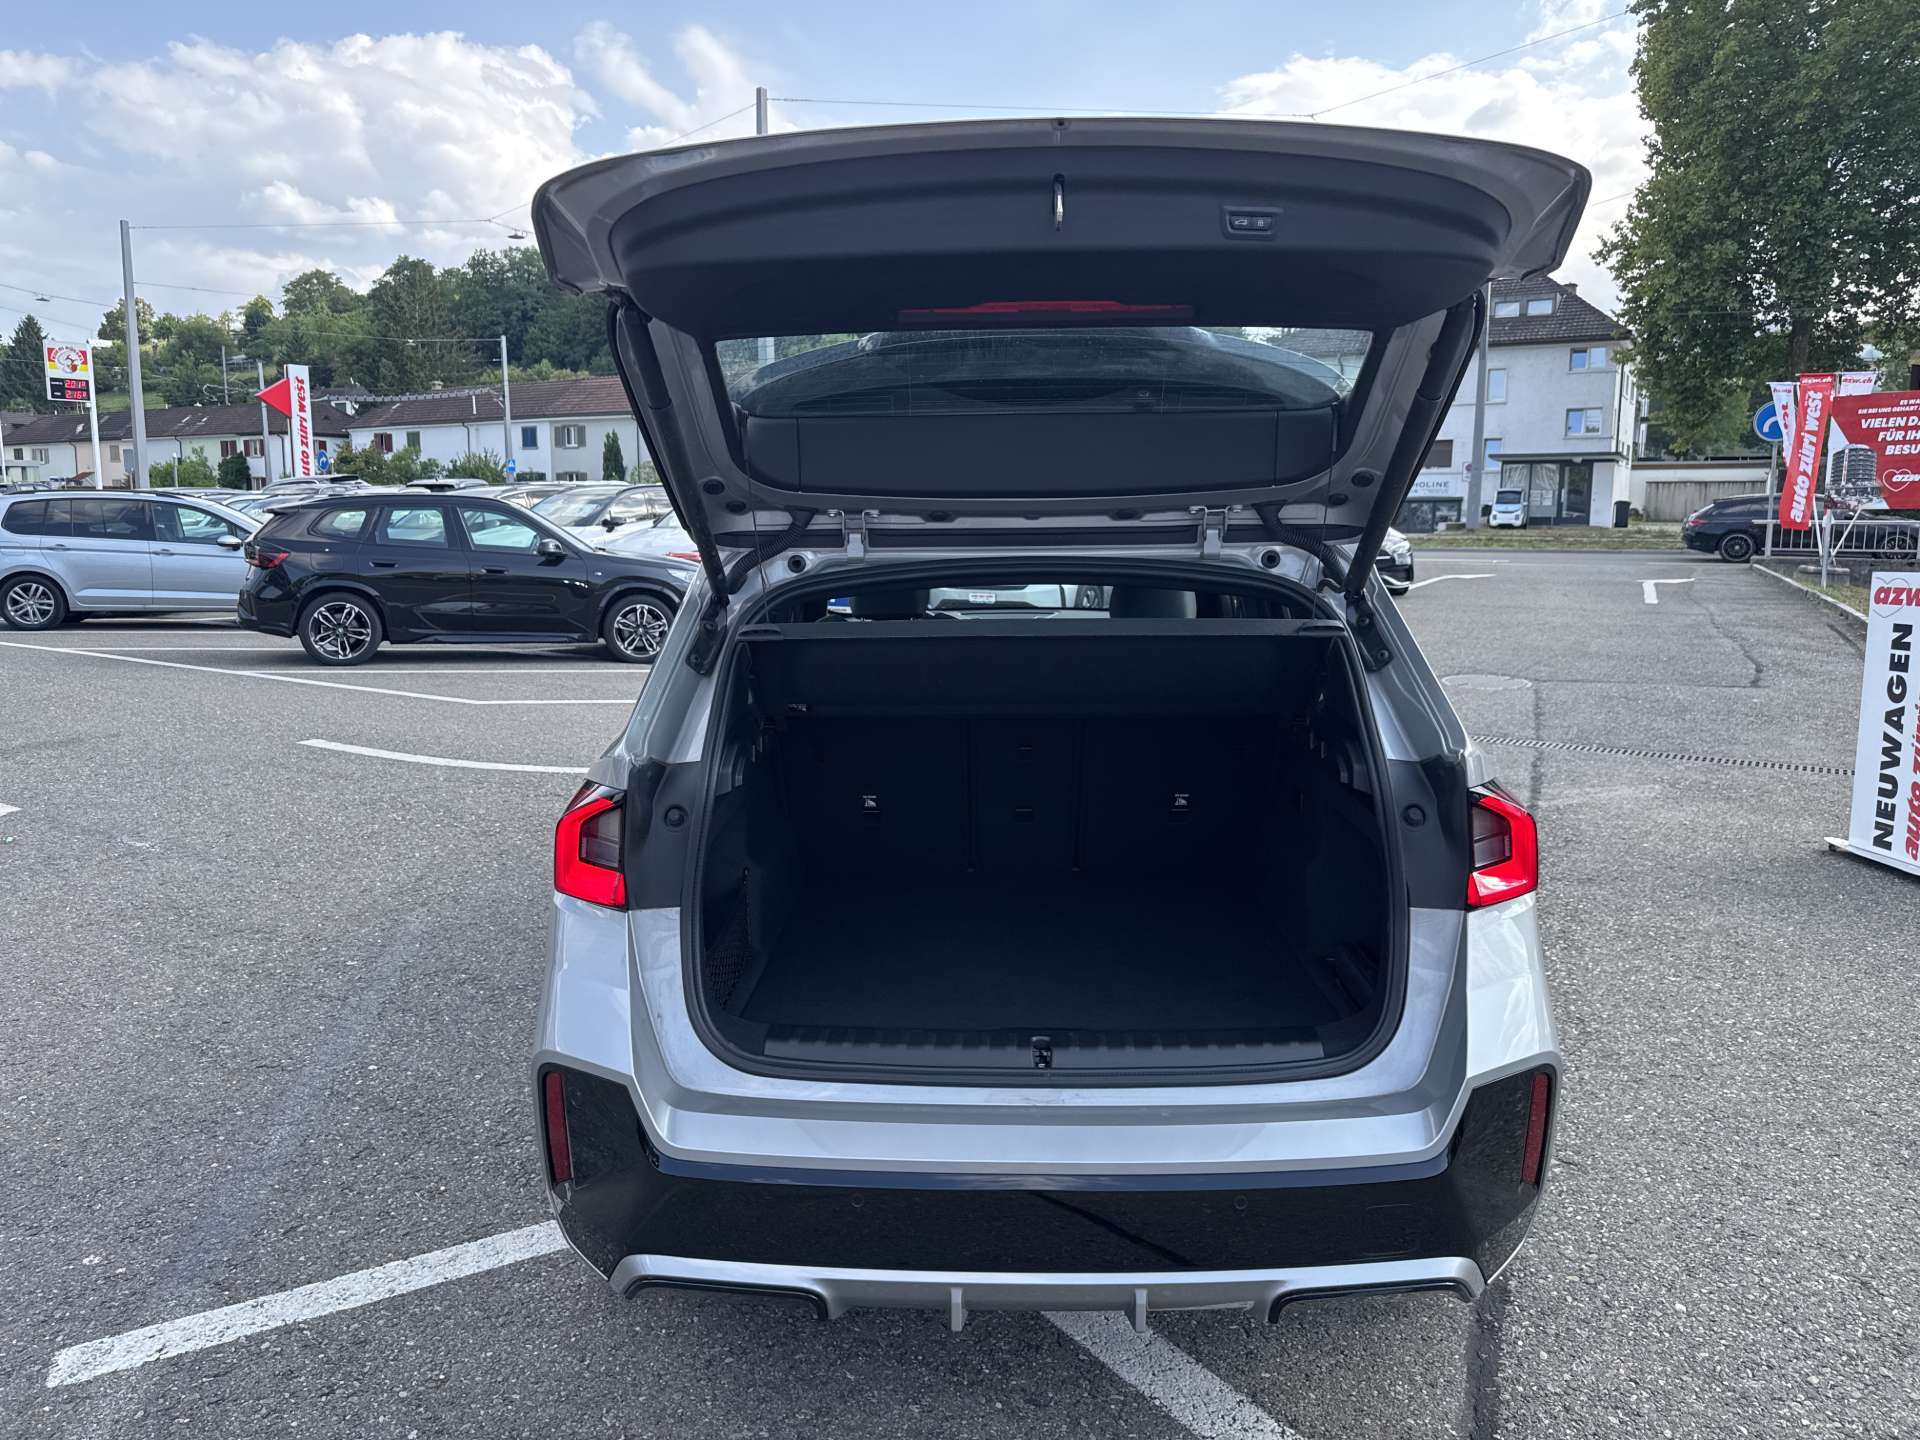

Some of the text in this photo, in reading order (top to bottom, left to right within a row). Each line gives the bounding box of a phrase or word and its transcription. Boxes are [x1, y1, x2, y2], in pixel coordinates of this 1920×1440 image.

[1861, 415, 1920, 428] VIELEN D
[1877, 428, 1905, 442] FÜR
[1790, 390, 1823, 522] auto züri west
[1885, 443, 1920, 456] BESU
[1872, 622, 1913, 852] NEUWAGEN
